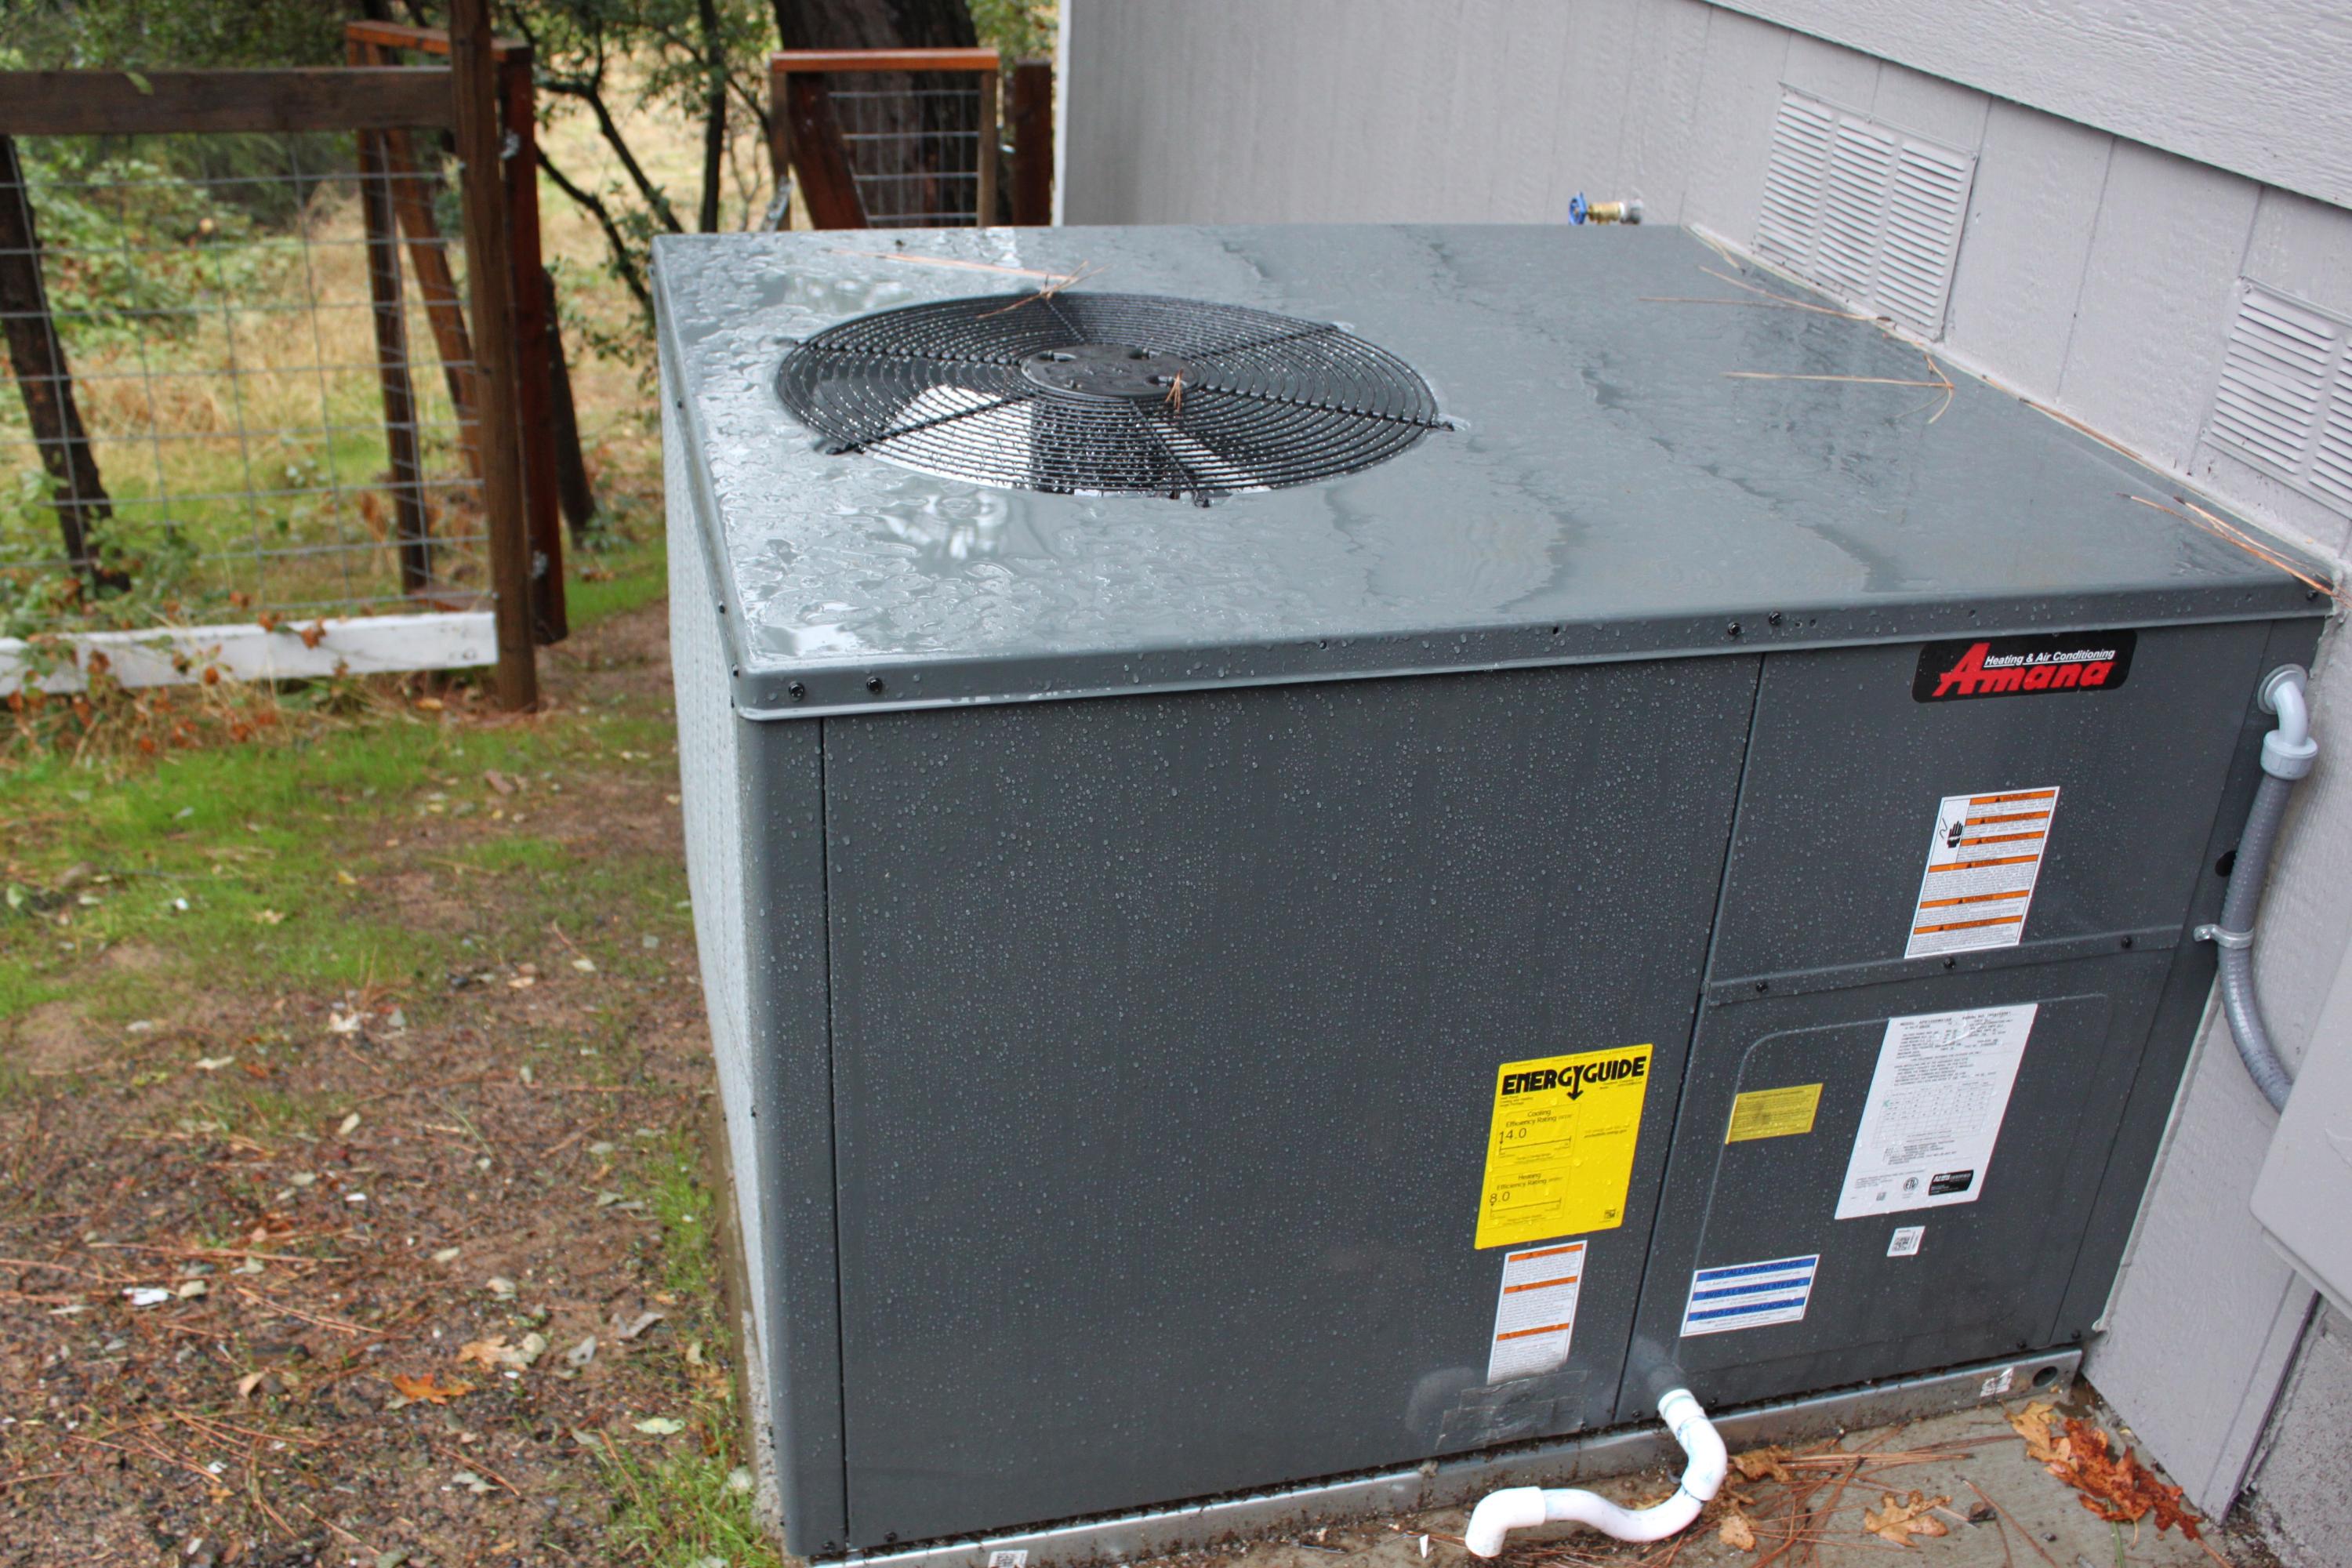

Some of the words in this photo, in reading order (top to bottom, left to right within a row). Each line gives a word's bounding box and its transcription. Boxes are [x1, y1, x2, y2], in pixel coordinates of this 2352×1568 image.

[1984, 655, 2024, 666] Heating
[2025, 653, 2034, 663] &
[2035, 652, 2051, 662] Air
[2053, 648, 2116, 662] Conditioning
[1932, 642, 2116, 697] Amana
[1527, 1109, 1552, 1118] Cooling
[1505, 1118, 1537, 1127] Efficiency
[1537, 1115, 1557, 1123] Rating
[1499, 1127, 1527, 1140] 14.0
[1496, 1181, 1526, 1191] Efficiency
[1490, 1192, 1511, 1203] 8.0
